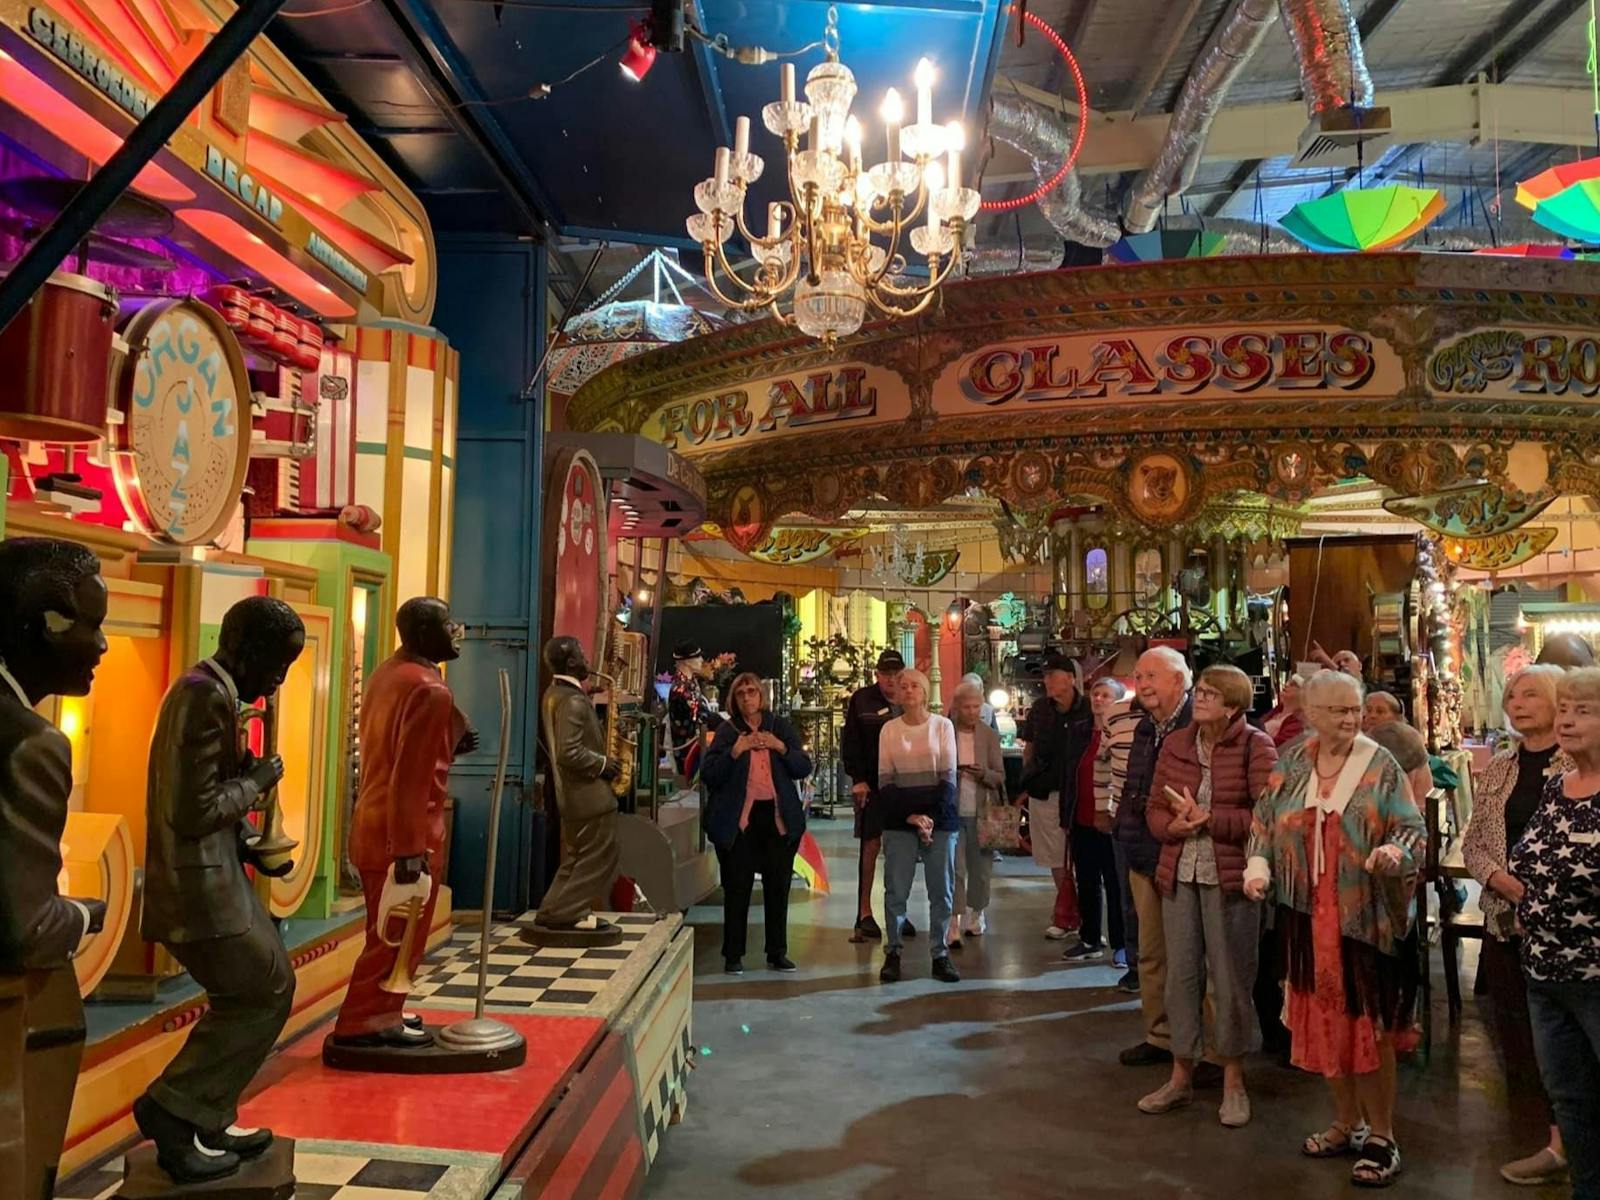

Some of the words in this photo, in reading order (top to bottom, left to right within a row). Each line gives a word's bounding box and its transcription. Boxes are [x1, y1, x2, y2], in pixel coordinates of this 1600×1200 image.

[28, 7, 159, 119] GEBROEDE
[205, 144, 284, 224] DECAP
[134, 318, 234, 438] ORGAN
[659, 389, 753, 449] FOR
[755, 367, 877, 431] ALL
[959, 330, 1377, 405] CLASSES
[167, 376, 193, 535] JAZZ
